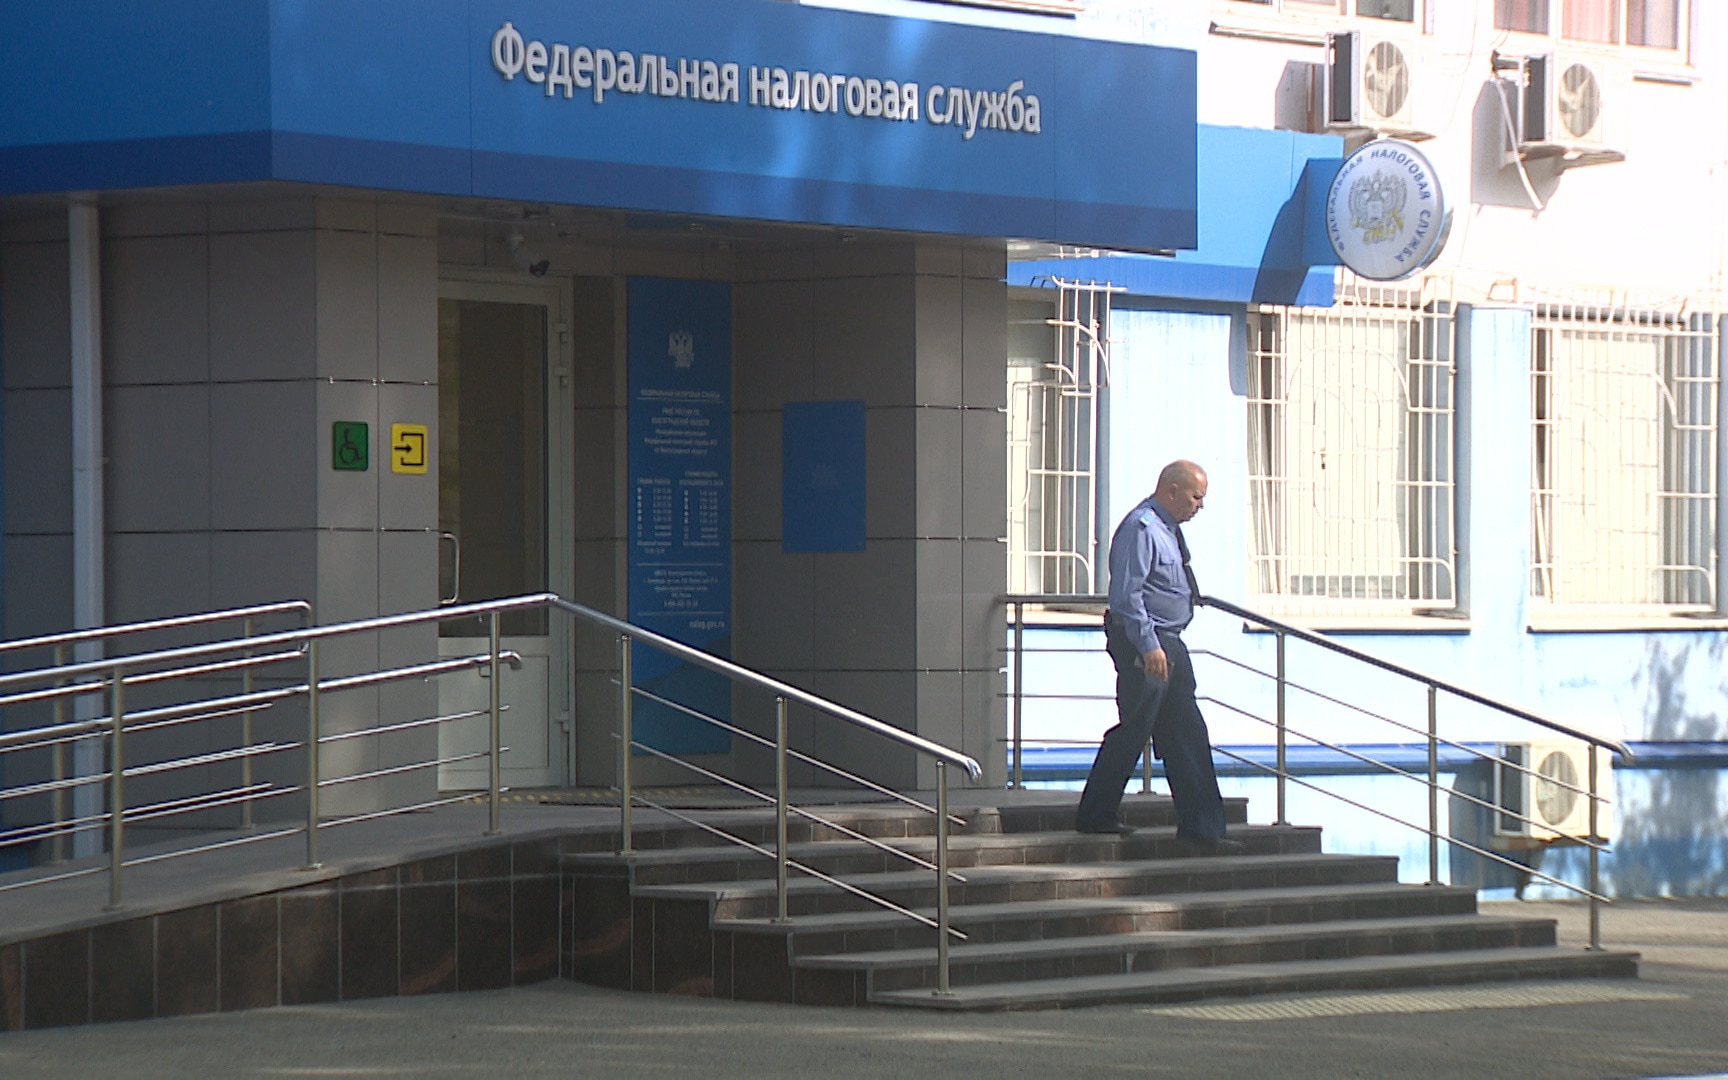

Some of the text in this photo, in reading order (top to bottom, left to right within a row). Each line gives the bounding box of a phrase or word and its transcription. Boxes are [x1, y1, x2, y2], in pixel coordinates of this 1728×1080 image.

[492, 21, 1041, 140] Федеральная налоговая служба
[1370, 149, 1431, 200] НАЛОГОВАЯ
[1394, 209, 1431, 262] СЛУЖБА
